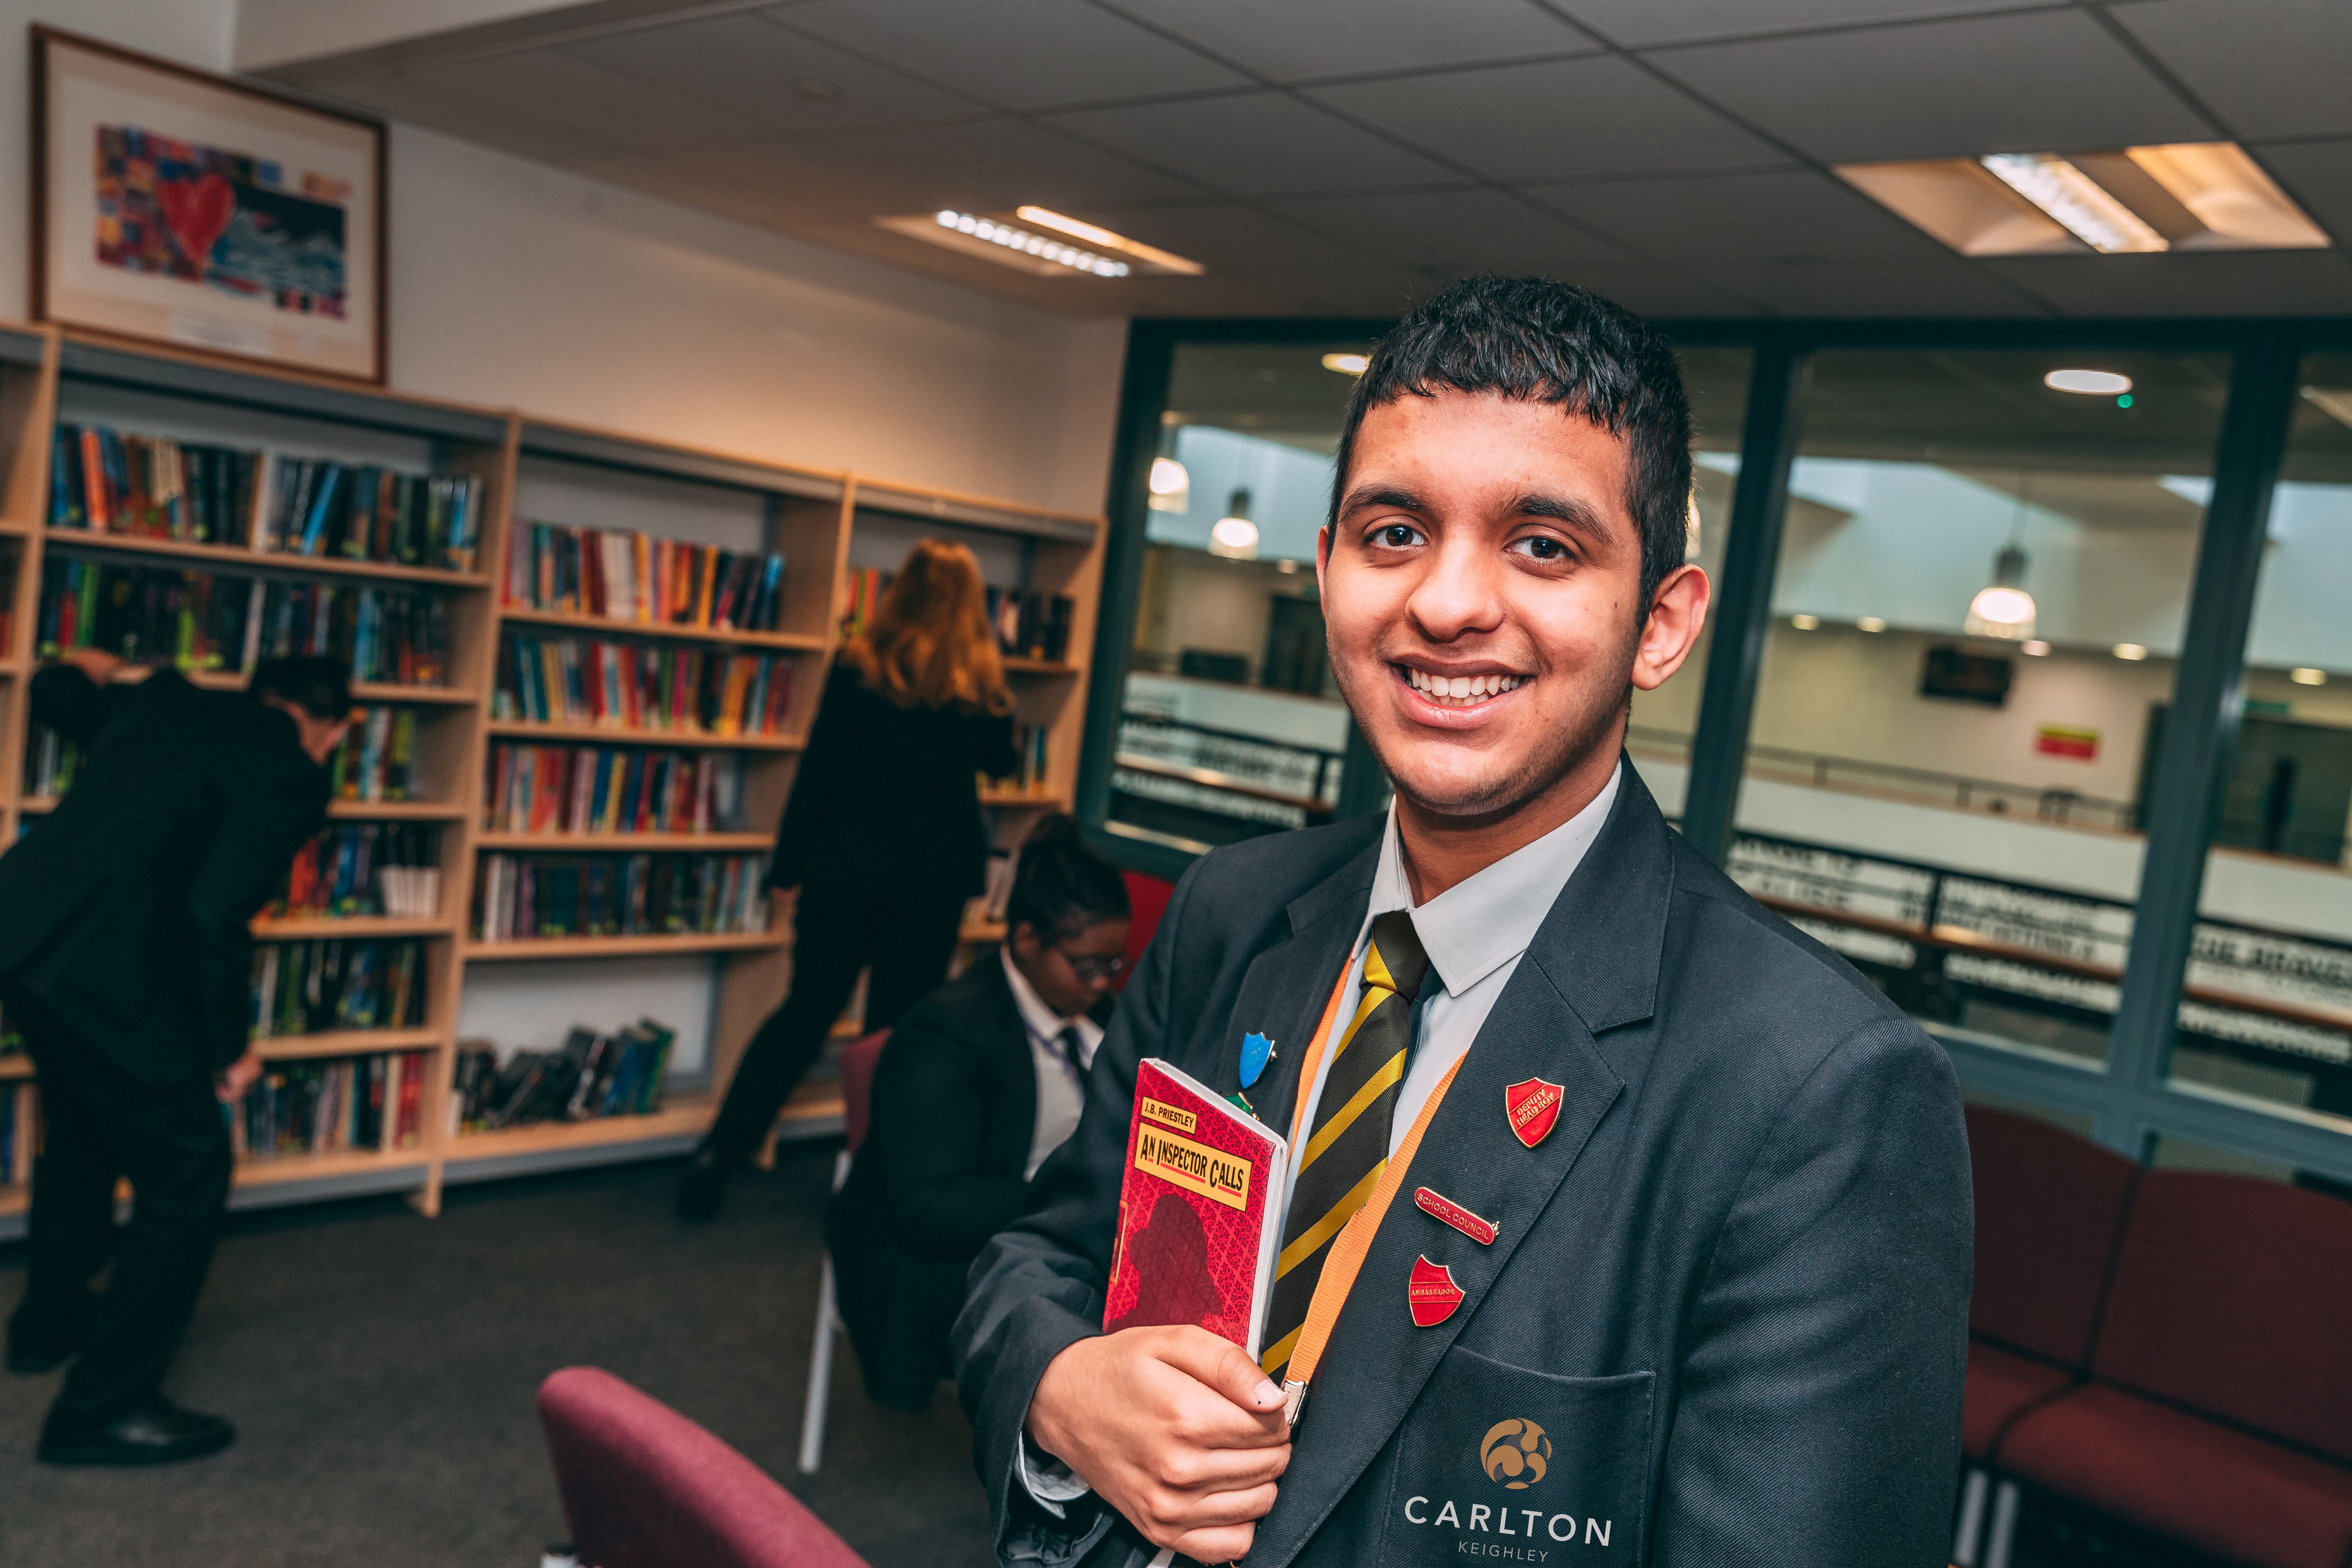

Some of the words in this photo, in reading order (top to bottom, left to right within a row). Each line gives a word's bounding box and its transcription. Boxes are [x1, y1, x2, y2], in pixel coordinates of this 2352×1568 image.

[1145, 1102, 1156, 1115] J.B.
[1159, 1106, 1194, 1128] PRIESTLEY
[1516, 1089, 1546, 1115] DEPUTY
[1516, 1106, 1538, 1126] HEAD
[1538, 1092, 1554, 1109] BOY
[1140, 1134, 1156, 1161] AN
[1157, 1139, 1207, 1177] INSPECTOR
[1210, 1159, 1244, 1191] CALLS
[1417, 1193, 1451, 1219] SCHOOL
[1453, 1213, 1489, 1240] COUNCIL
[1411, 1288, 1455, 1296] AMBASSADOR
[1405, 1496, 1611, 1547] CARLTON
[1458, 1541, 1549, 1562] KEIGHLEY
